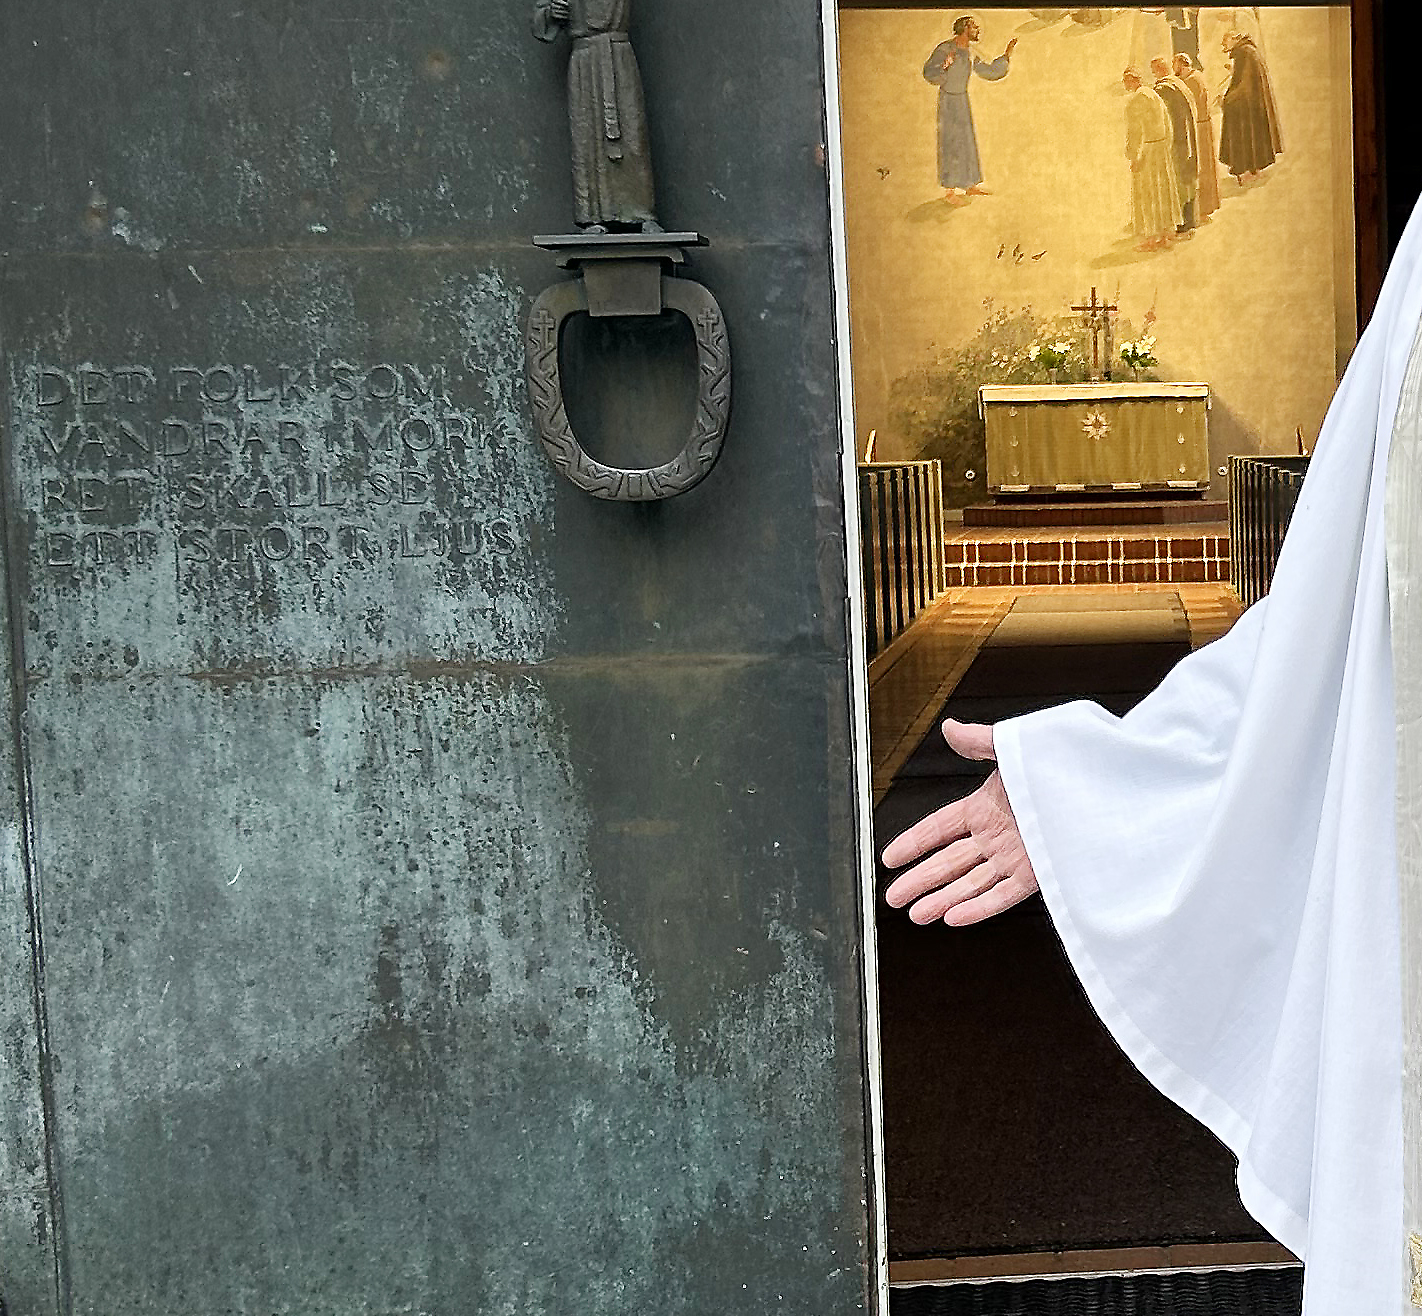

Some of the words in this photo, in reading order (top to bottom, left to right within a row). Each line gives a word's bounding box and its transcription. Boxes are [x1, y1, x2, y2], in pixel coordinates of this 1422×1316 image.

[36, 364, 156, 406] DET
[169, 364, 308, 402] FOLK
[330, 361, 448, 404] SOM
[40, 417, 309, 457] VANDRAR
[42, 470, 155, 511] RET
[183, 472, 346, 509] SKALL
[366, 472, 430, 505] SE
[46, 530, 156, 566] ETT
[177, 527, 369, 563] STORT
[400, 518, 516, 558] LJUS
